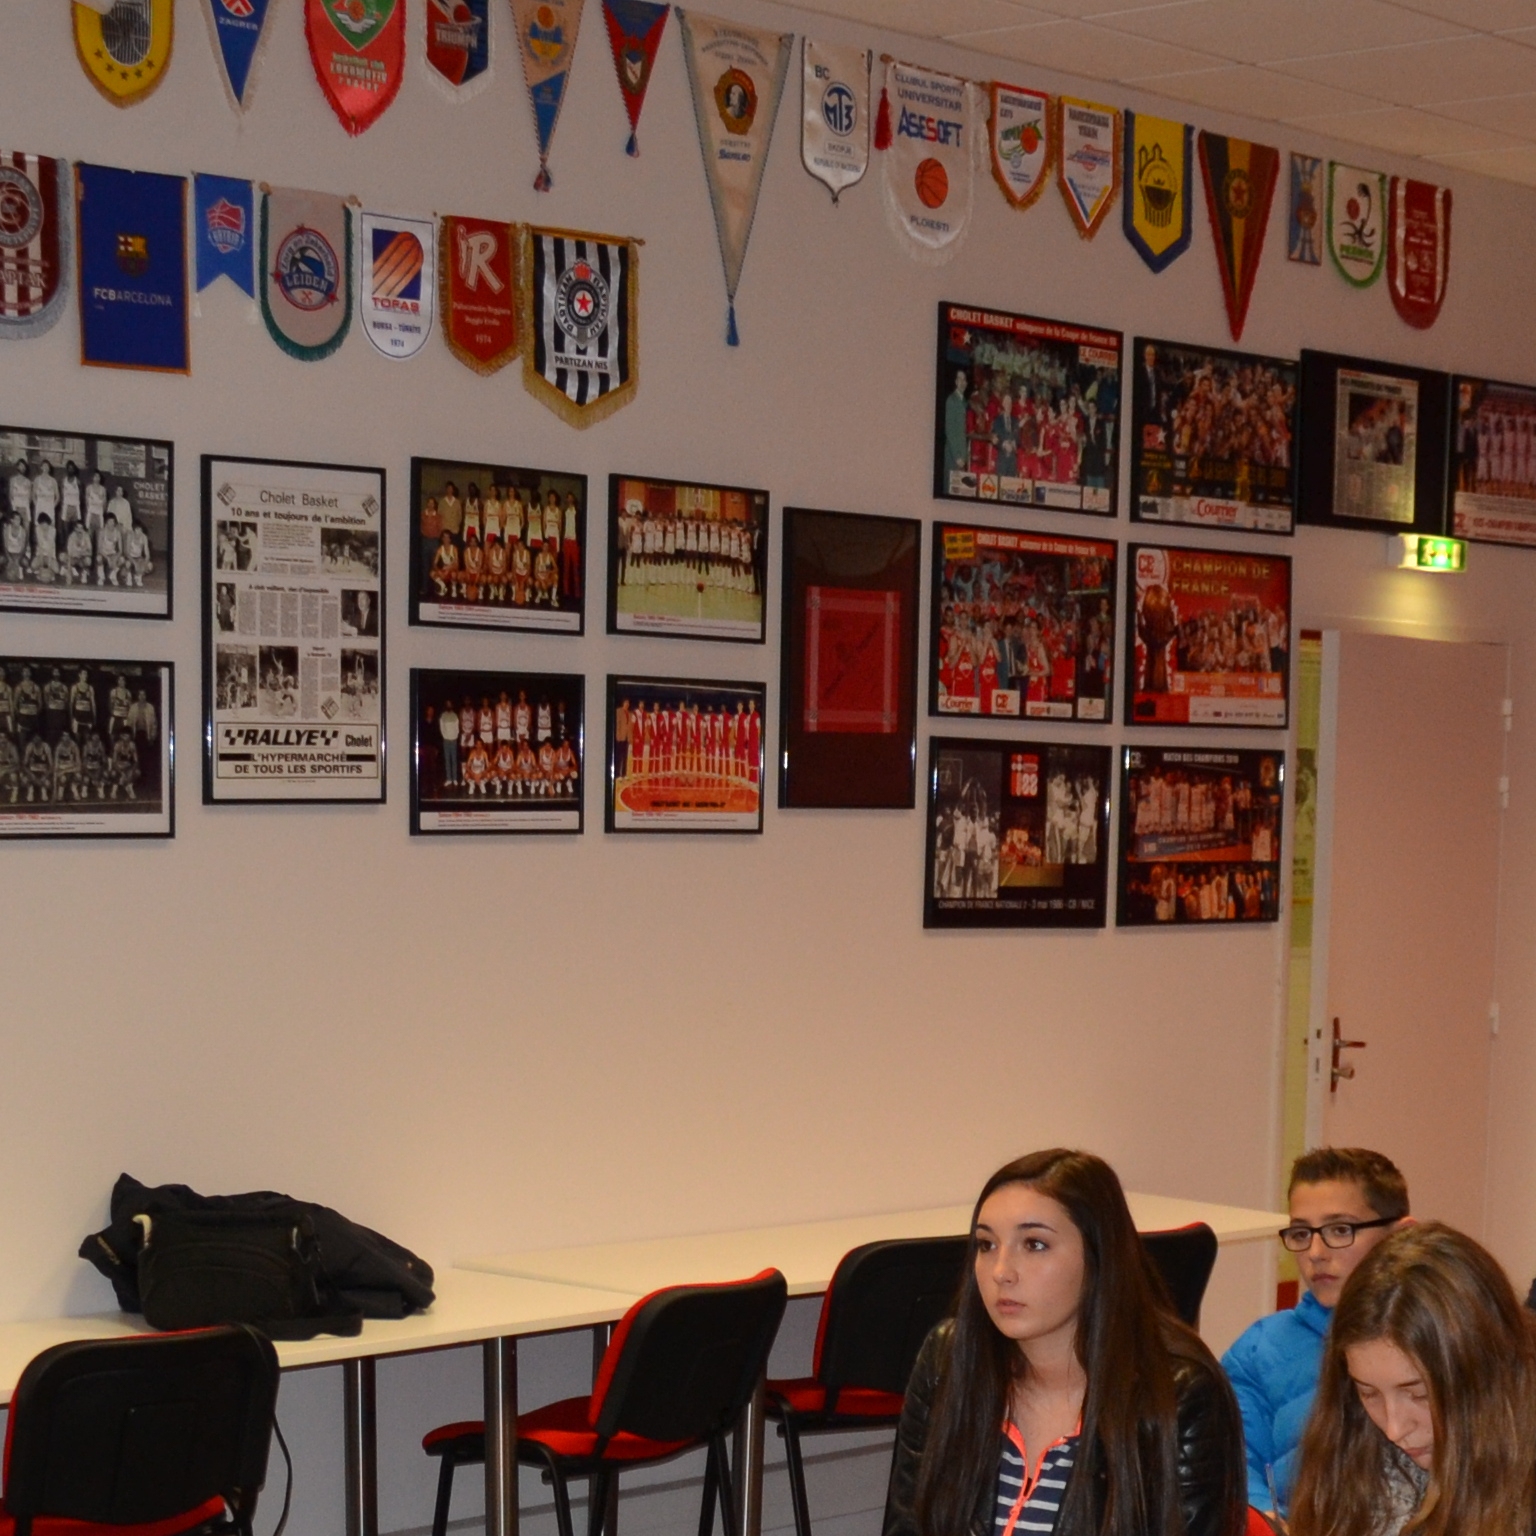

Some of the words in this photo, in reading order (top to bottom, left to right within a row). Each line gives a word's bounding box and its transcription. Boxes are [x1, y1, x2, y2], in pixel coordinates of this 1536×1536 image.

[815, 64, 830, 80] BC
[895, 73, 929, 90] CLUBUL
[897, 87, 962, 112] UNIVERSITAR
[897, 104, 963, 148] ASESOFT
[285, 275, 329, 291] LEIDEN
[94, 287, 173, 308] FCBARCELONA
[949, 307, 982, 325] CHOLET
[983, 312, 1015, 329] BASKET
[554, 356, 594, 369] PARTIZAN
[133, 481, 166, 492] CHOLET
[138, 491, 168, 501] BASKE
[259, 489, 296, 506] Cholet
[301, 494, 339, 509] Basket
[231, 507, 243, 517] 10
[244, 510, 260, 519] ans
[262, 510, 272, 519] et
[274, 511, 309, 523] toujours
[311, 513, 322, 523] de
[324, 514, 366, 527] l'ambition
[1195, 498, 1239, 520] Courrier
[1172, 556, 1247, 578] CHAMPION
[1252, 562, 1271, 580] DE
[1172, 578, 1230, 597] FRANCE
[944, 697, 974, 710] Courrier
[243, 729, 321, 746] RALLYE
[345, 734, 373, 748] Cholet
[251, 751, 347, 763] L'HYPERMARCHÉ
[234, 764, 249, 774] DE
[254, 765, 283, 774] TOUS
[287, 765, 306, 774] LES
[310, 765, 363, 775] SPORTIFS
[938, 899, 966, 910] CHAMPION
[974, 899, 994, 910] FRANCE
[995, 899, 1022, 910] NATIONALE
